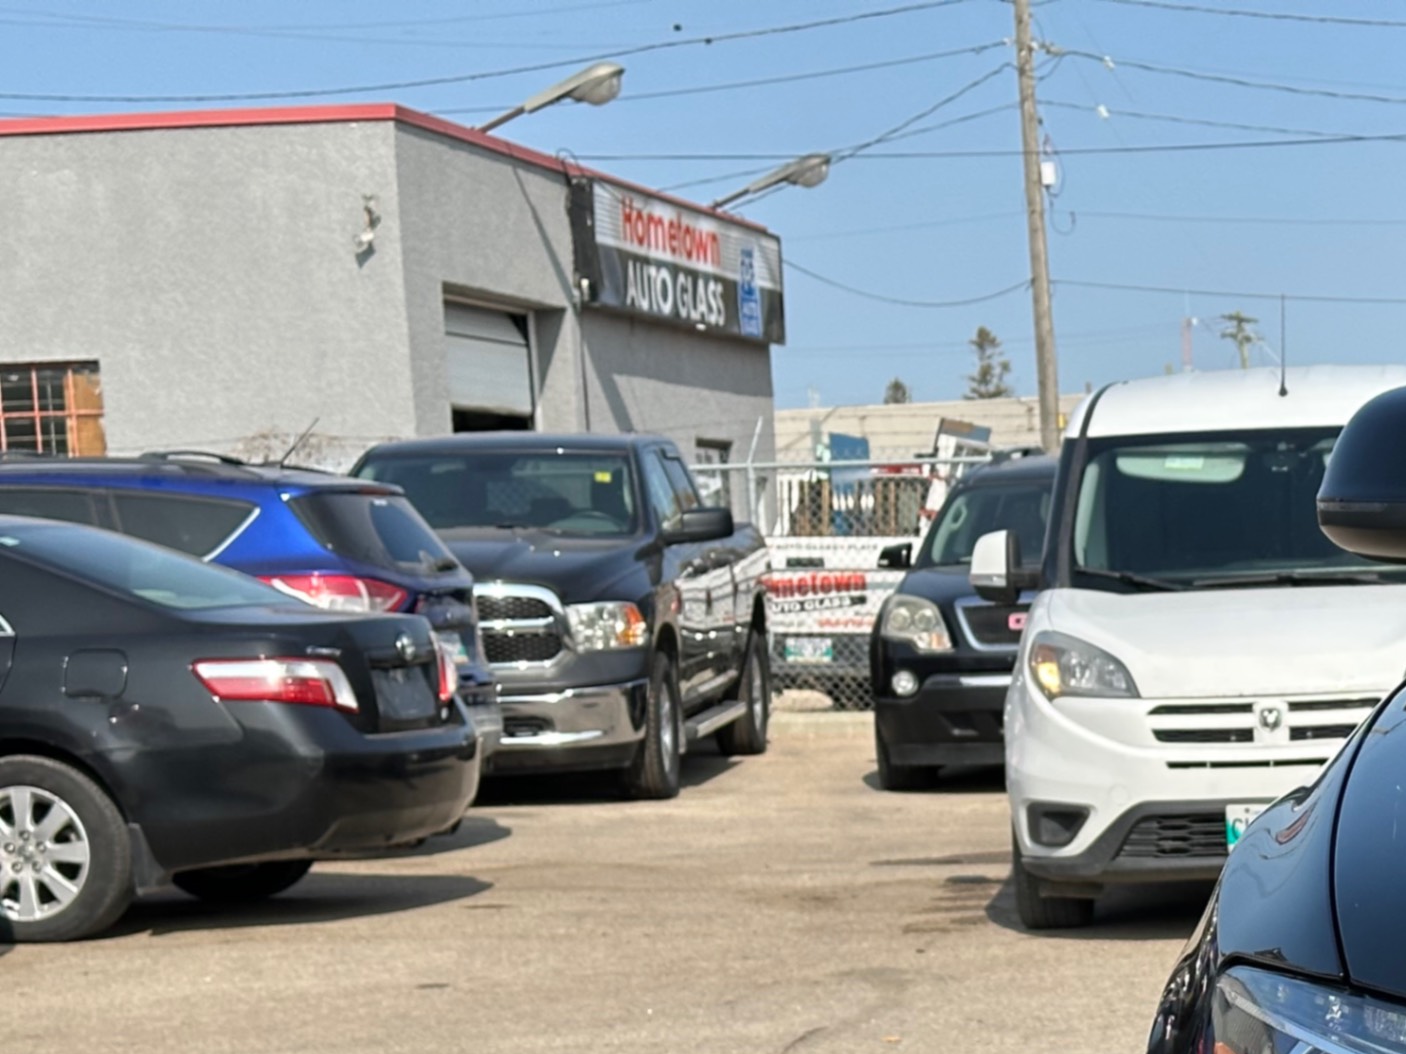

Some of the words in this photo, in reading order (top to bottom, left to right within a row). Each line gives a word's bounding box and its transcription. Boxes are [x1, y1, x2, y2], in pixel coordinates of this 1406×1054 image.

[621, 198, 721, 267] Hometown
[626, 260, 674, 316] AUTO
[676, 271, 726, 327] GLASS
[804, 597, 851, 611] GLASS
